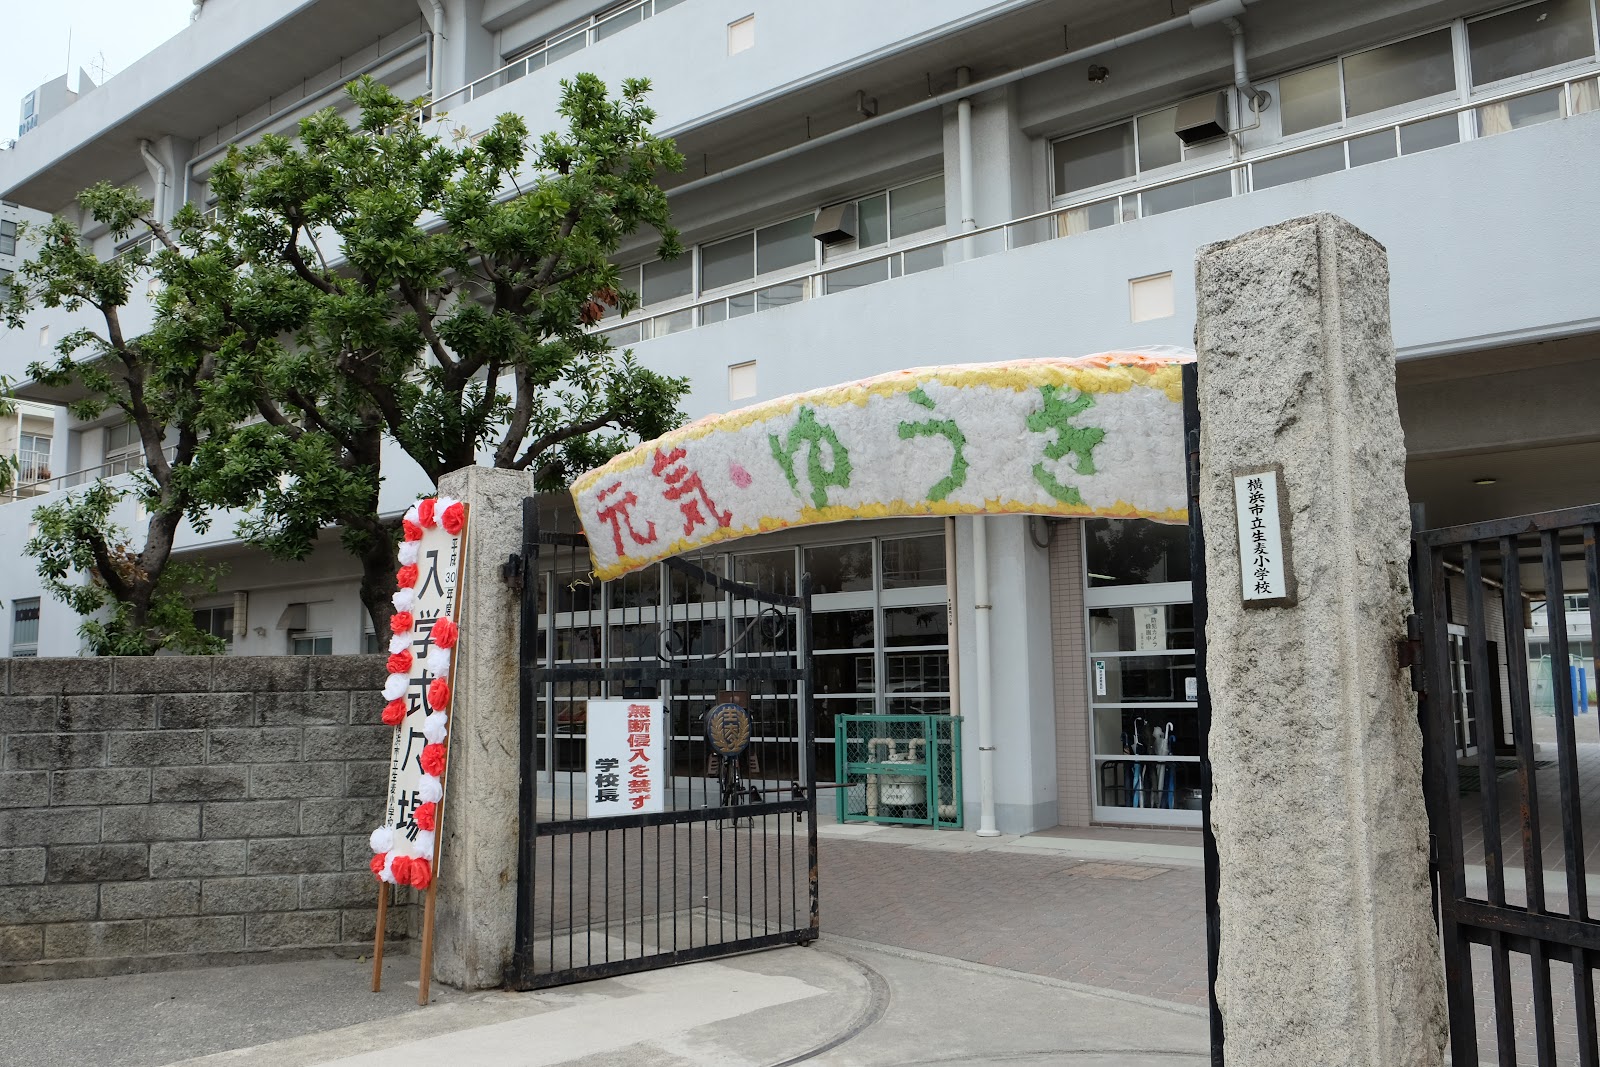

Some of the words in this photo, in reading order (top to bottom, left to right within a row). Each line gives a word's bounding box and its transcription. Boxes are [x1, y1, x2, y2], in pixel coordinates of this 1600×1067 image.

[596, 446, 732, 557] 元気
[768, 384, 1105, 509] ゆうき
[445, 537, 459, 617] 平成30年度
[1247, 477, 1273, 595] 横浜市立生麦小学校
[594, 757, 620, 804] 学校長
[626, 703, 652, 811] 無断侵入を禁ず
